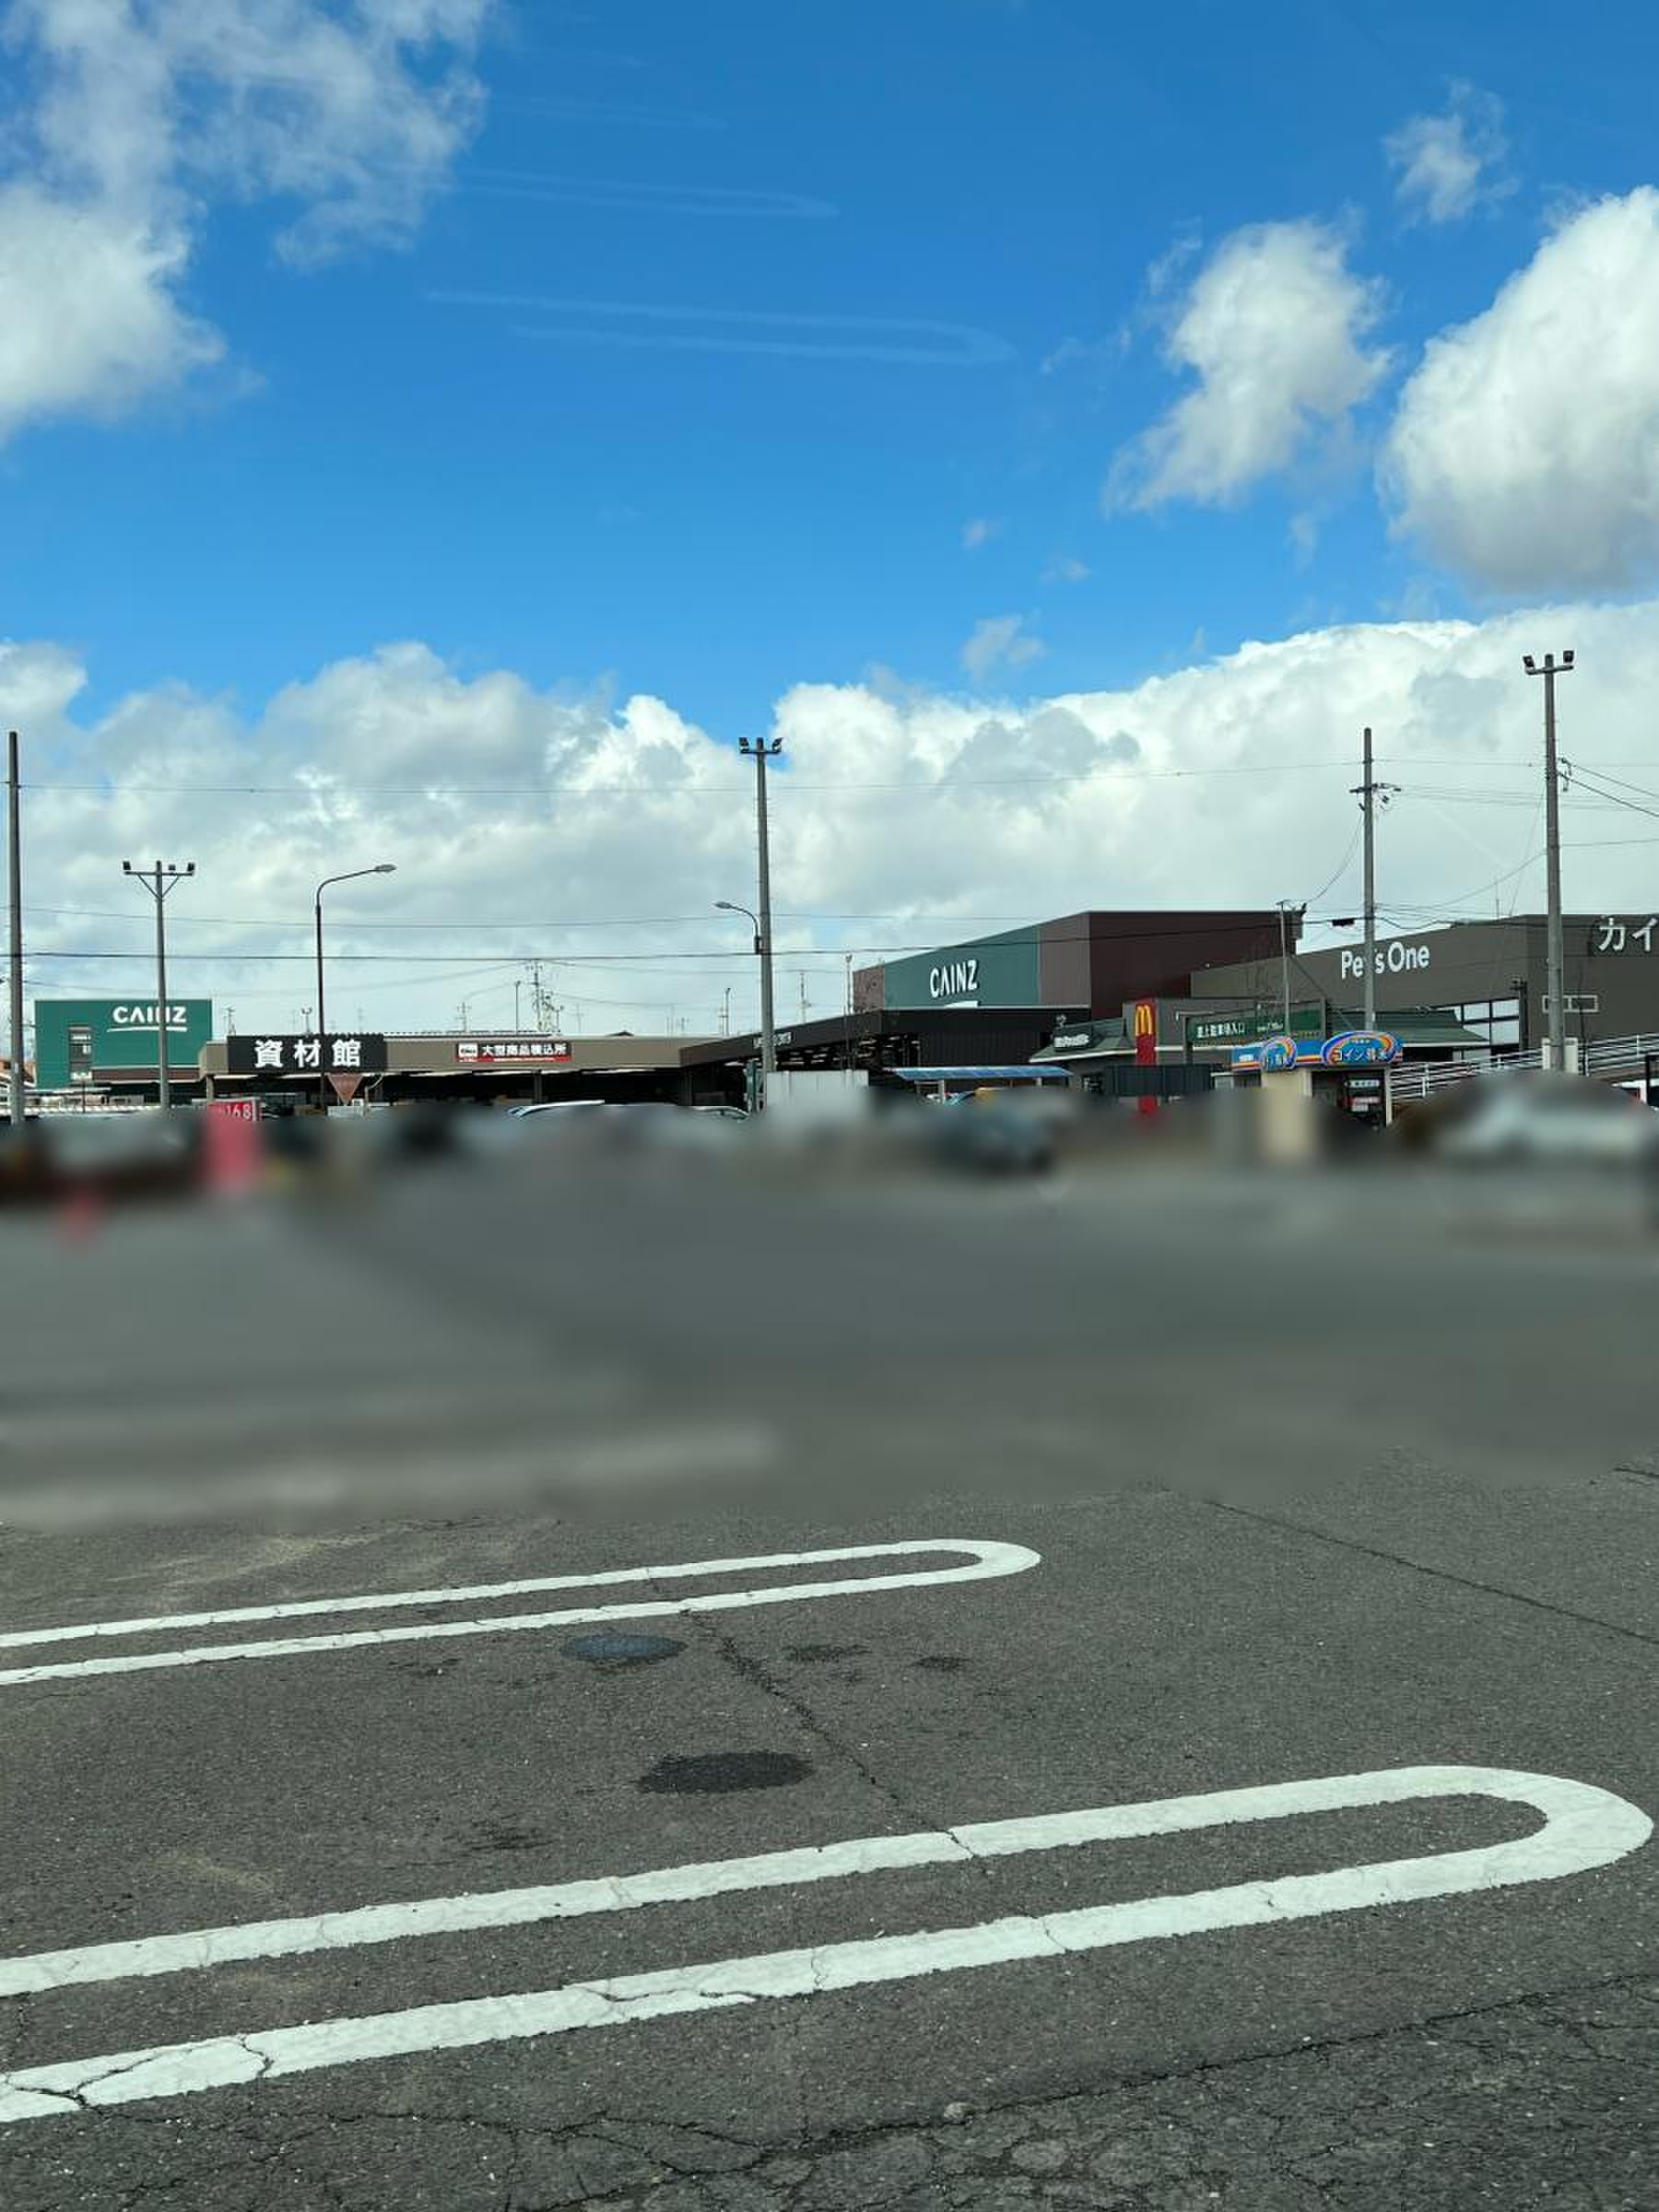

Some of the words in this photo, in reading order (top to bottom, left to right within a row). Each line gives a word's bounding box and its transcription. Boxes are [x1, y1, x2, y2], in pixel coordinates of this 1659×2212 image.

[1598, 917, 1658, 951] カイ
[1341, 941, 1430, 980] Pe'sOne
[930, 959, 979, 998] CAINZ
[112, 1006, 187, 1024] CAINZ
[254, 1039, 361, 1068] 資材館
